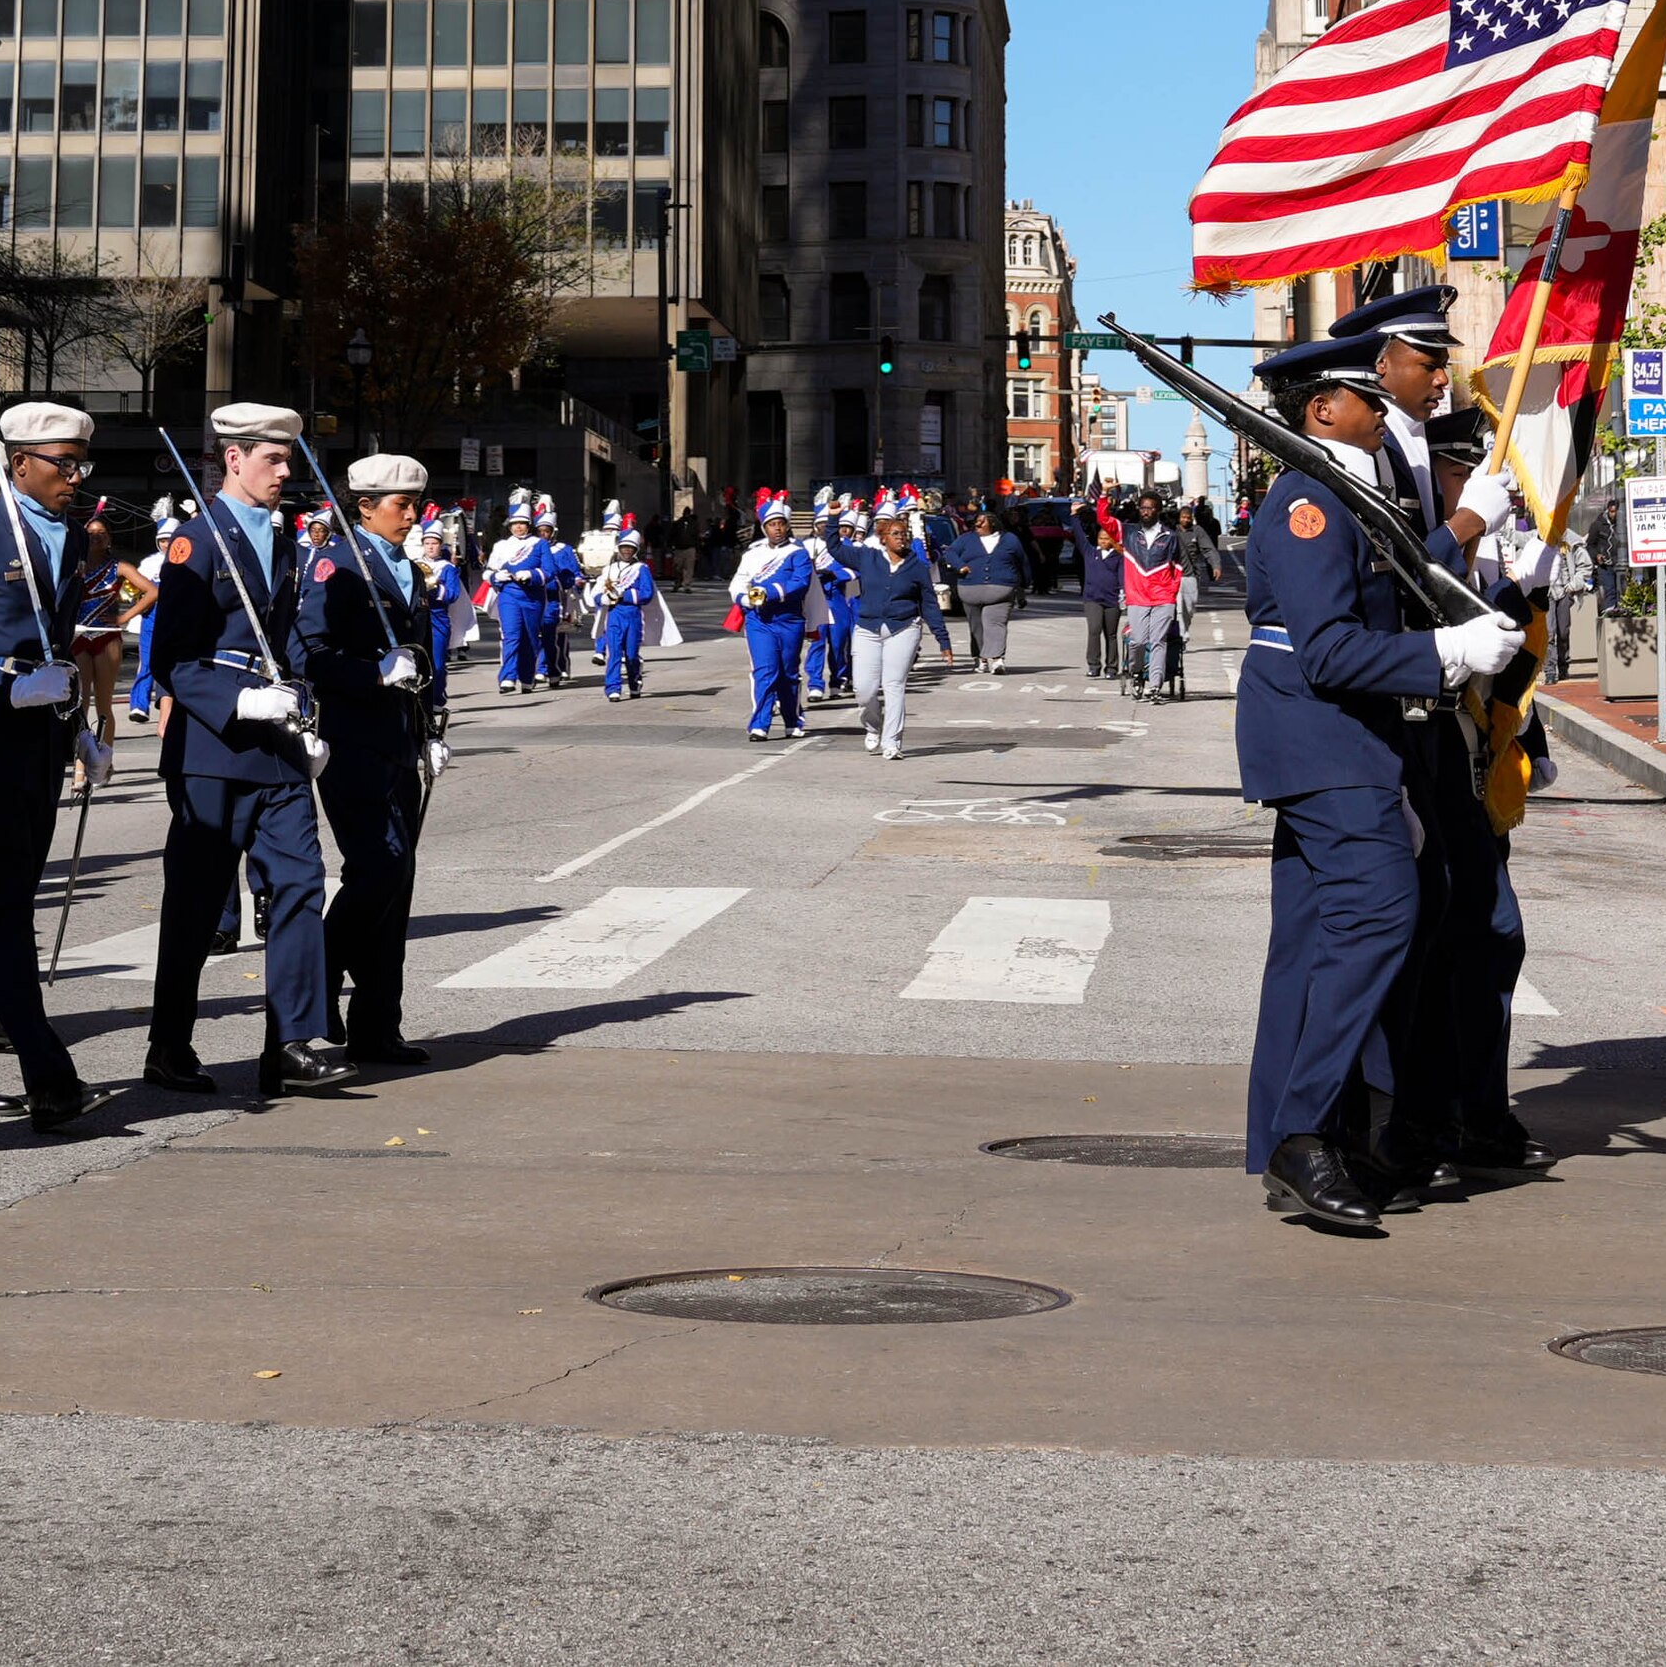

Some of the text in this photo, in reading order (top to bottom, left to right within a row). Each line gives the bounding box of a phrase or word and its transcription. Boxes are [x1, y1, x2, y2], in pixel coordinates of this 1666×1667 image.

[1458, 205, 1471, 249] CAND
[1634, 362, 1661, 379] $4.75
[1634, 485, 1644, 496] NO
[1636, 523, 1656, 531] 7AM
[1636, 551, 1652, 561] TOW
